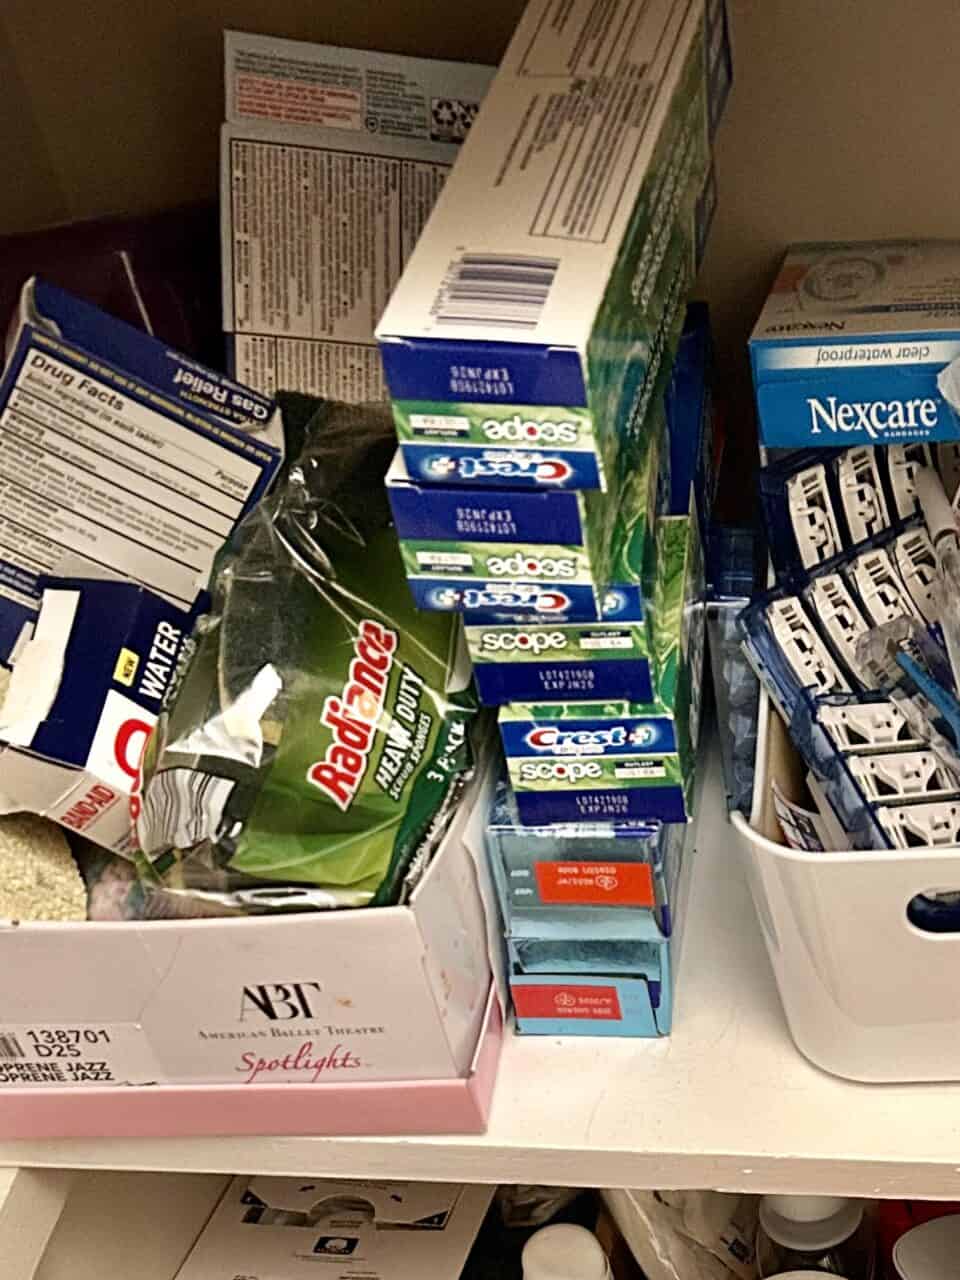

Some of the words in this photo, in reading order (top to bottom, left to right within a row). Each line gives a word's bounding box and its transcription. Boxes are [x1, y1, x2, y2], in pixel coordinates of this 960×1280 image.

[816, 347, 892, 366] waterproof
[896, 345, 931, 359] clear
[30, 354, 74, 387] Drug
[78, 379, 125, 412] Facts
[173, 368, 231, 402] Relief
[231, 394, 268, 421] Gas
[806, 396, 938, 438] Nexcare
[480, 415, 577, 441] scope
[459, 457, 570, 483] Crest
[486, 552, 576, 578] scope
[463, 587, 571, 613] Crest
[481, 631, 568, 653] scope
[138, 619, 181, 698] WATER
[307, 620, 399, 811] Radiance
[374, 718, 414, 791] HEAVY
[397, 665, 423, 722] DUTY
[525, 727, 627, 749] Crest
[425, 769, 444, 784] 3
[520, 761, 603, 782] scope
[60, 785, 116, 829] BAND-AID
[240, 981, 322, 1022] ABT
[26, 1029, 112, 1045] 138701
[198, 1028, 267, 1041] AMERICAN
[269, 1027, 323, 1039] BALLET
[326, 1025, 385, 1037] THEATRE
[35, 1044, 82, 1058] D25
[234, 1041, 362, 1084] Spotlights
[0, 1062, 59, 1073] PRENE
[66, 1061, 110, 1073] JAZZ
[72, 1070, 116, 1082] JAZZ
